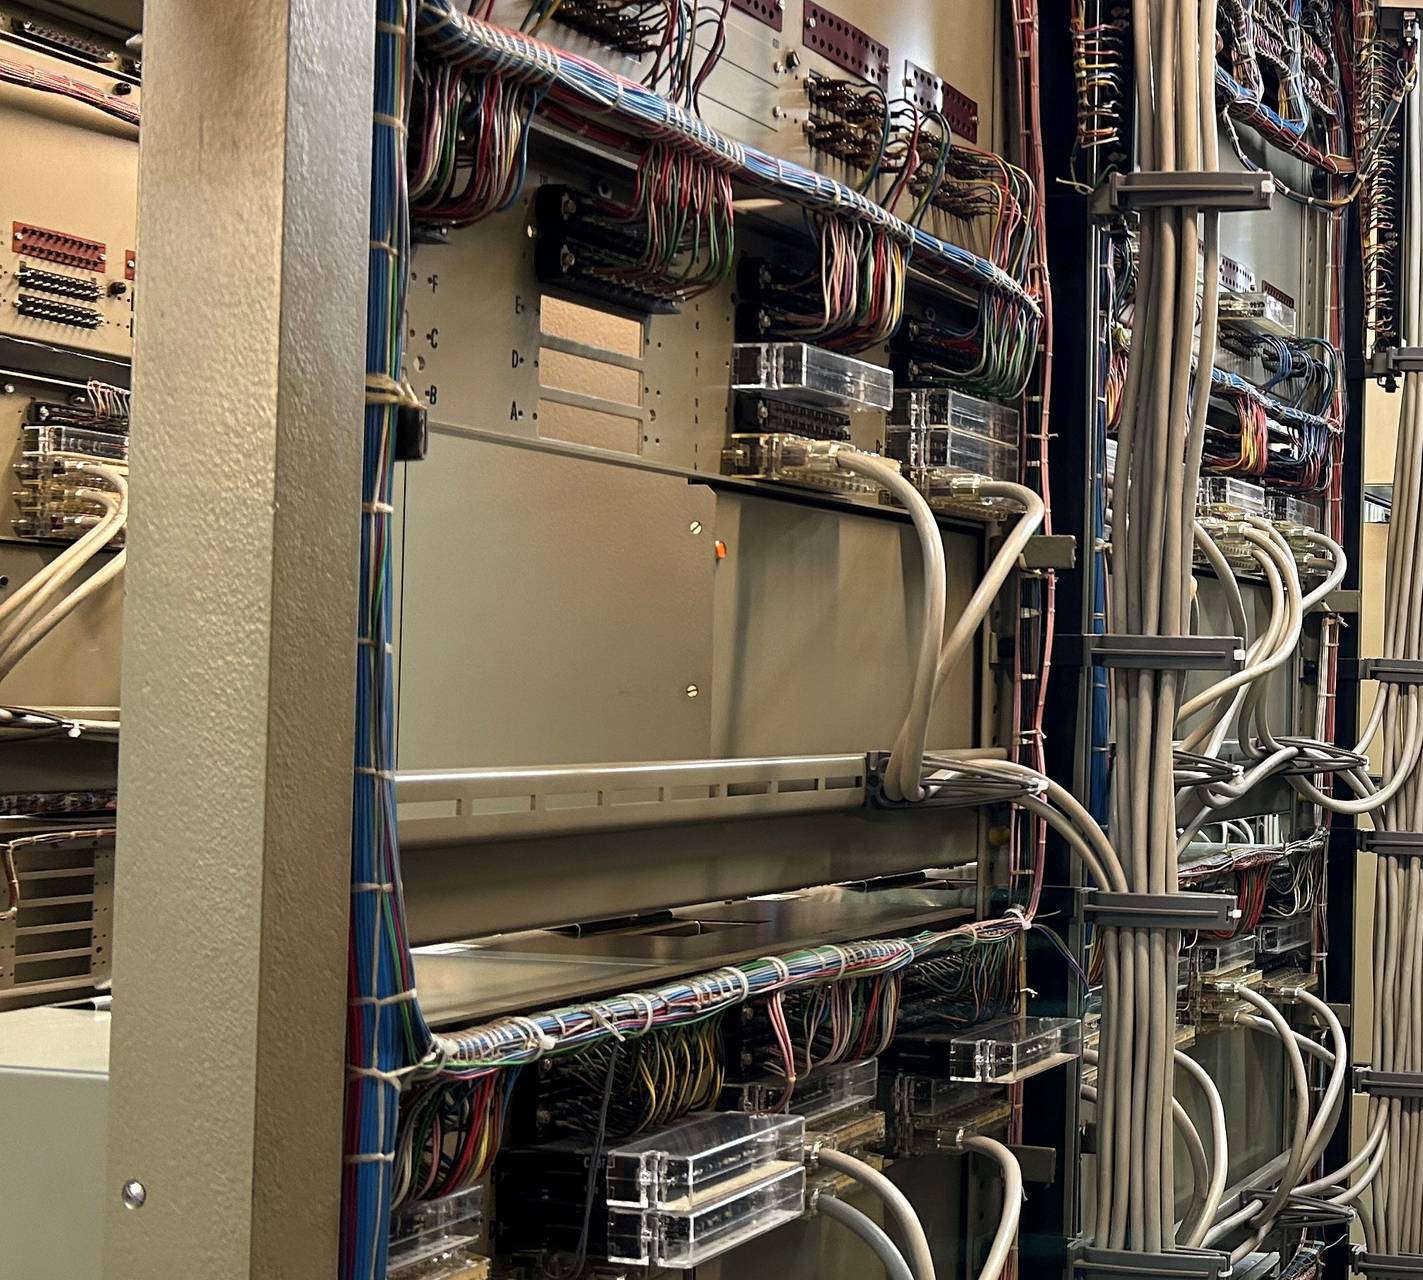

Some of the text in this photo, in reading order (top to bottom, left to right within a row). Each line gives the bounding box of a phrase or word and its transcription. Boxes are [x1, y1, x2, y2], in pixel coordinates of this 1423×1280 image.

[432, 274, 438, 293] F
[515, 296, 521, 314] E
[430, 328, 438, 348] C
[512, 349, 518, 368] D
[429, 385, 437, 405] B
[510, 401, 518, 421] A
